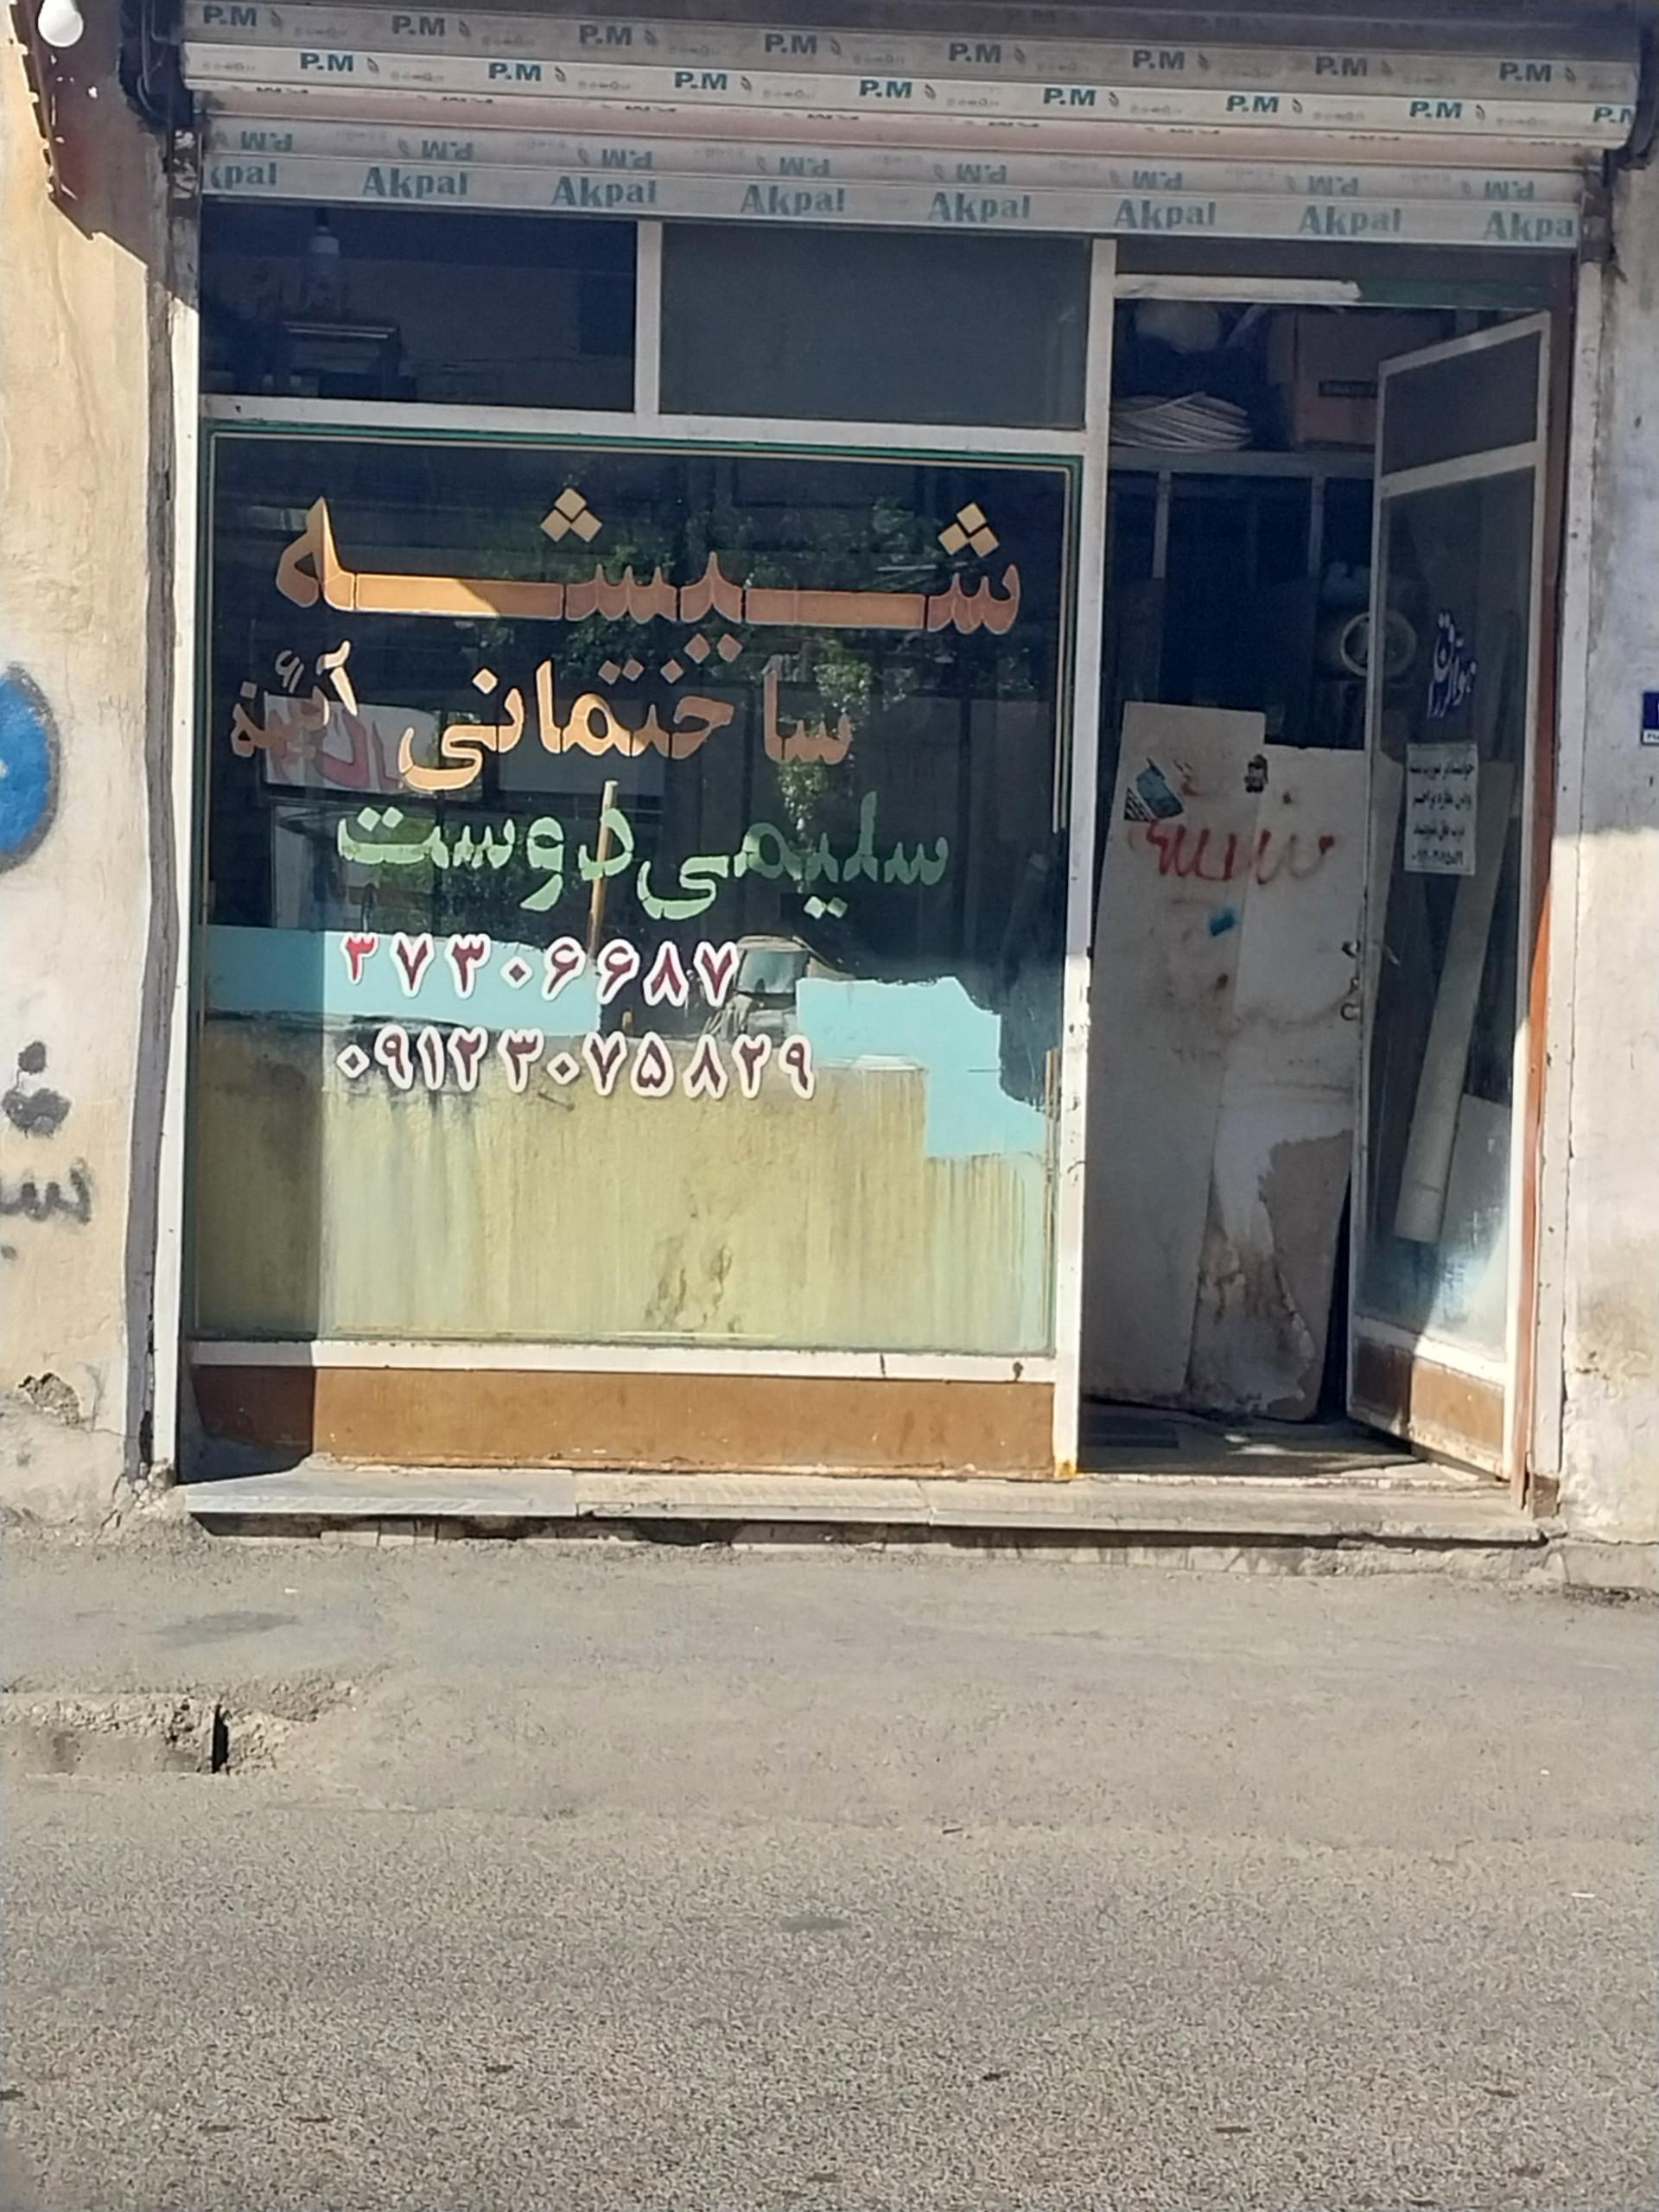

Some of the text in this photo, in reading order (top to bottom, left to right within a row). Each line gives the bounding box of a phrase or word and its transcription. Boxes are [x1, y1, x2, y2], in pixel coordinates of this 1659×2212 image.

[203, 5, 1552, 82] P.M P.M P.M P.M P.M P.M P.M P.M
[300, 53, 353, 72] P.M
[488, 62, 542, 82] P.M
[674, 73, 728, 91] P.M
[859, 80, 912, 99] P.M
[1043, 87, 1096, 106] P.M
[1226, 95, 1279, 113] P.M
[1409, 101, 1462, 119] P.M
[363, 166, 467, 198] Akpal
[552, 175, 657, 207] Akpal
[740, 184, 845, 216] Akpal
[928, 192, 1031, 223] Akpal
[1114, 199, 1217, 230] Akpal
[1299, 206, 1402, 236] Akpal
[1481, 210, 1573, 242] Akpa
[275, 486, 1020, 664] شیشه
[336, 805, 634, 912] دوست
[340, 933, 740, 1008] ۳۷۳۰۶۶۸۷
[335, 1023, 817, 1101] ۰۹۱۲۳۰۷۵۸۲۹
